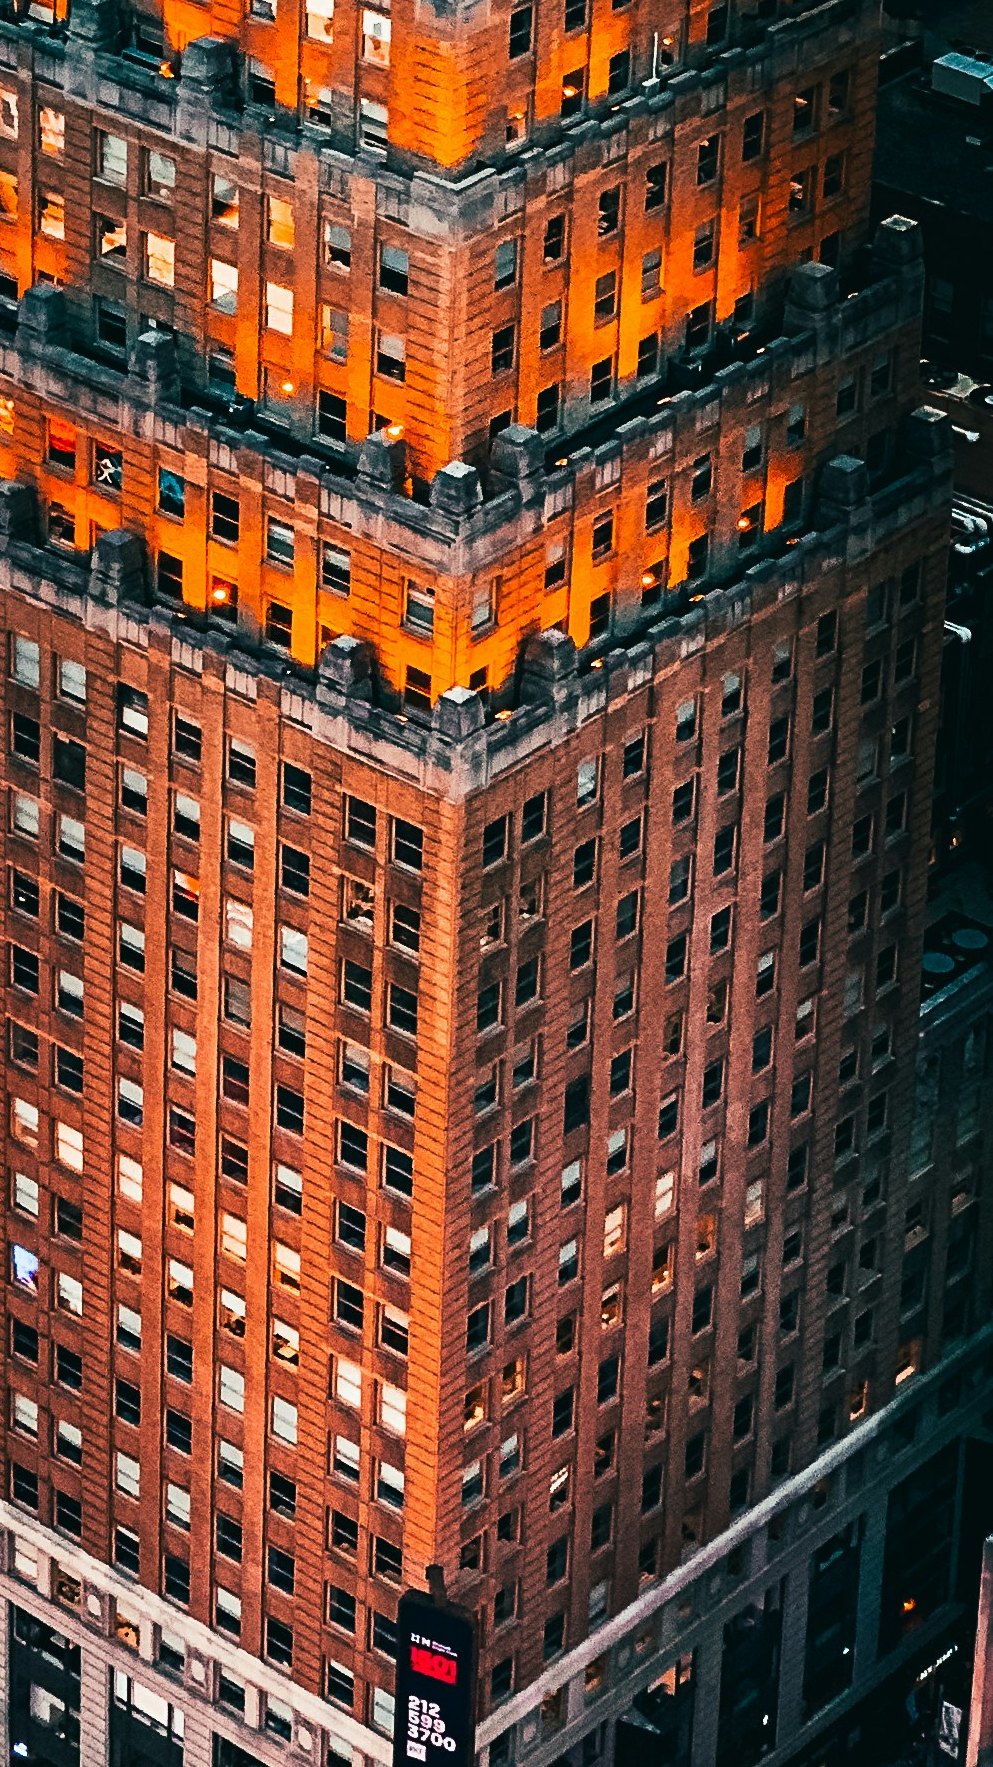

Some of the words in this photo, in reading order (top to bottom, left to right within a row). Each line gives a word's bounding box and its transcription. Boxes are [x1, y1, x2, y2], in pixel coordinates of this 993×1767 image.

[408, 1695, 441, 1719] 212
[408, 1709, 446, 1734] 599
[407, 1723, 457, 1752] 3700
